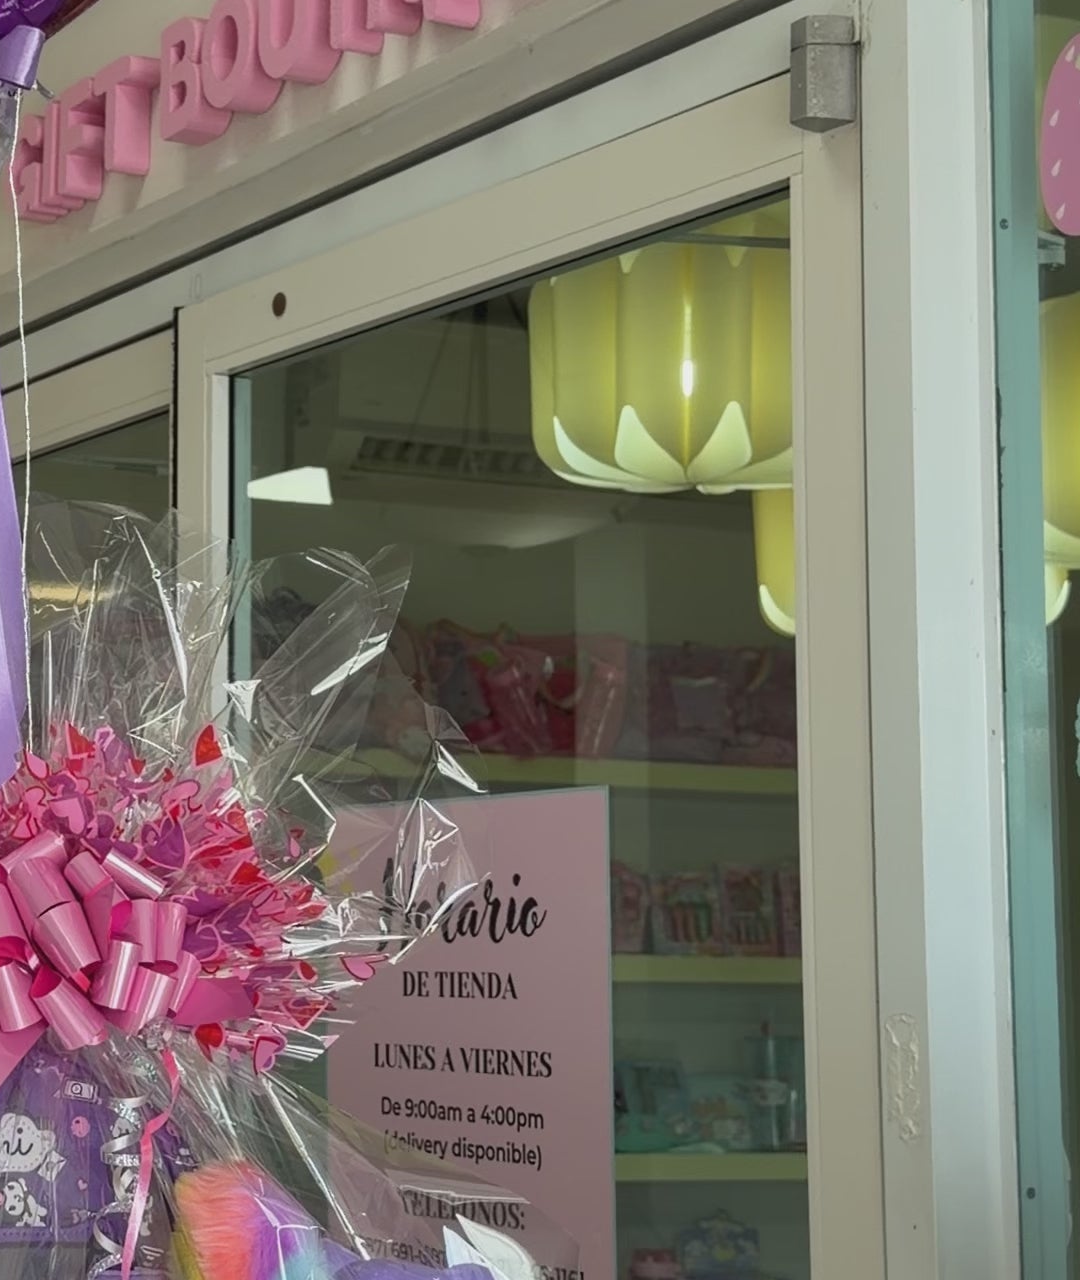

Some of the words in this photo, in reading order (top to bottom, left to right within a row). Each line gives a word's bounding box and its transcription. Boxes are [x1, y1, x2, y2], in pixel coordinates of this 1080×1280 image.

[403, 971, 429, 997] DE
[435, 971, 518, 999] TIENDA
[374, 1043, 436, 1070] LUNES
[441, 1047, 455, 1072] A
[460, 1047, 552, 1078] VIERNES
[381, 1096, 401, 1116] De
[405, 1098, 462, 1122] 9:00am
[467, 1108, 475, 1123] a
[481, 1105, 544, 1132] 4:00pm
[452, 1137, 542, 1171] disponible)
